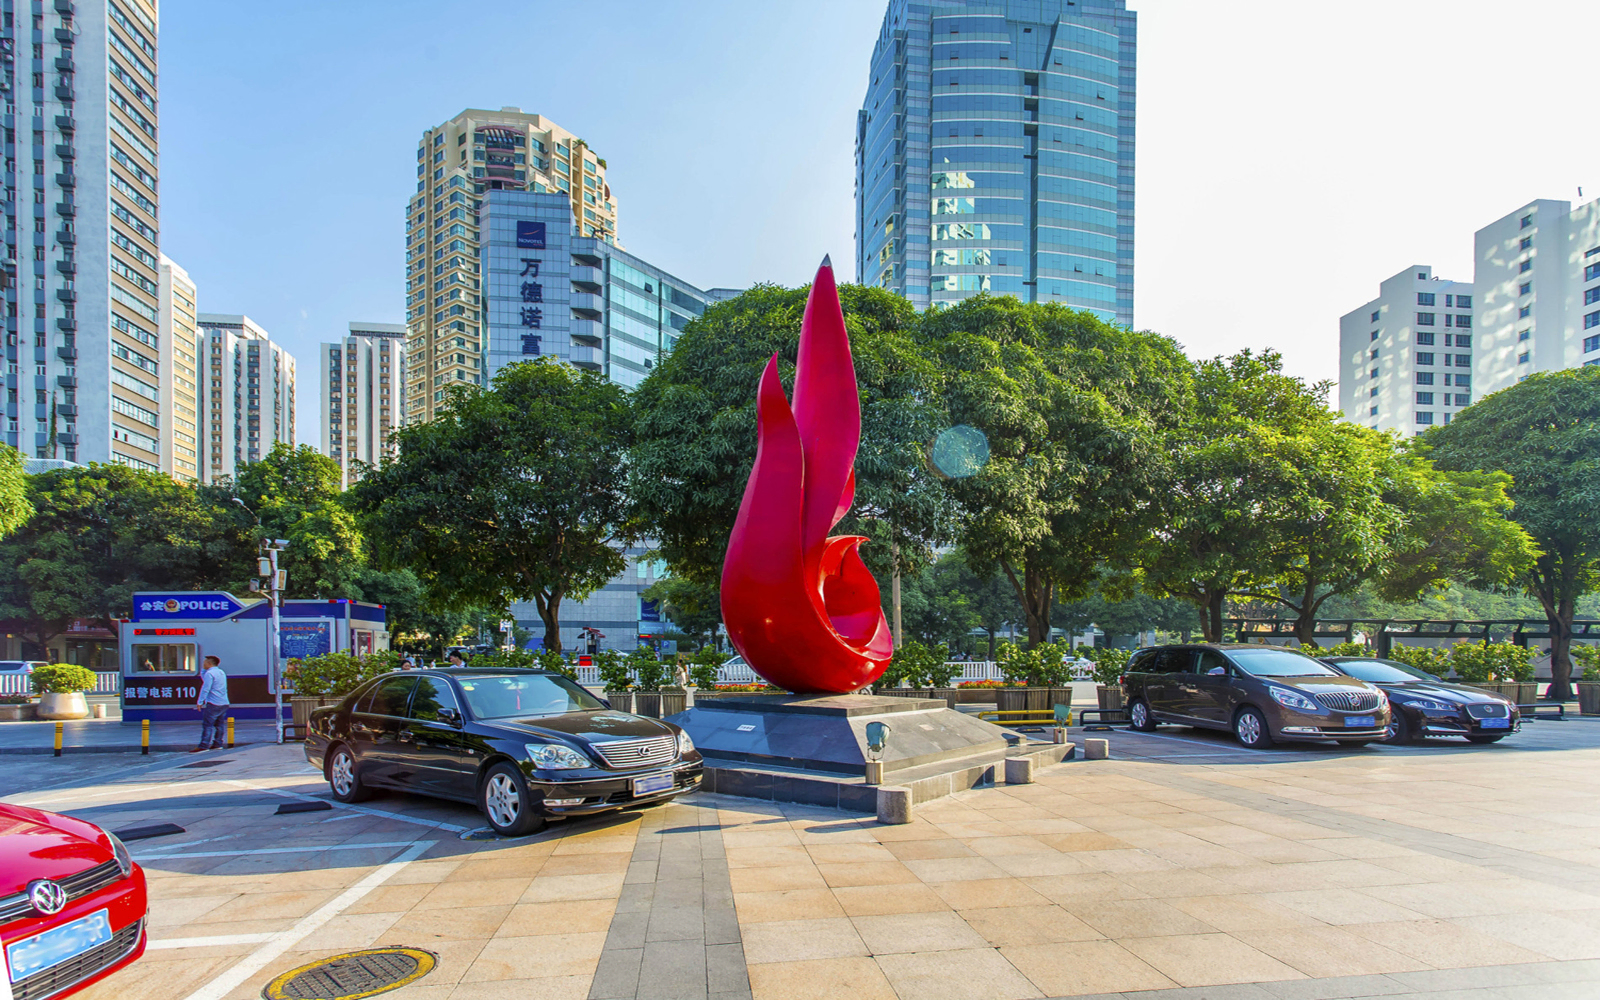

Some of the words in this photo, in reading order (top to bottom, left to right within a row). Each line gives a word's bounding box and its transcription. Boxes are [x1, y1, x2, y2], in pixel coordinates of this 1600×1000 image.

[520, 258, 543, 364] 万德诺富
[140, 601, 164, 611] 公安
[180, 601, 229, 610] POLICE
[124, 687, 173, 698] 报警电话
[175, 686, 196, 698] 110
